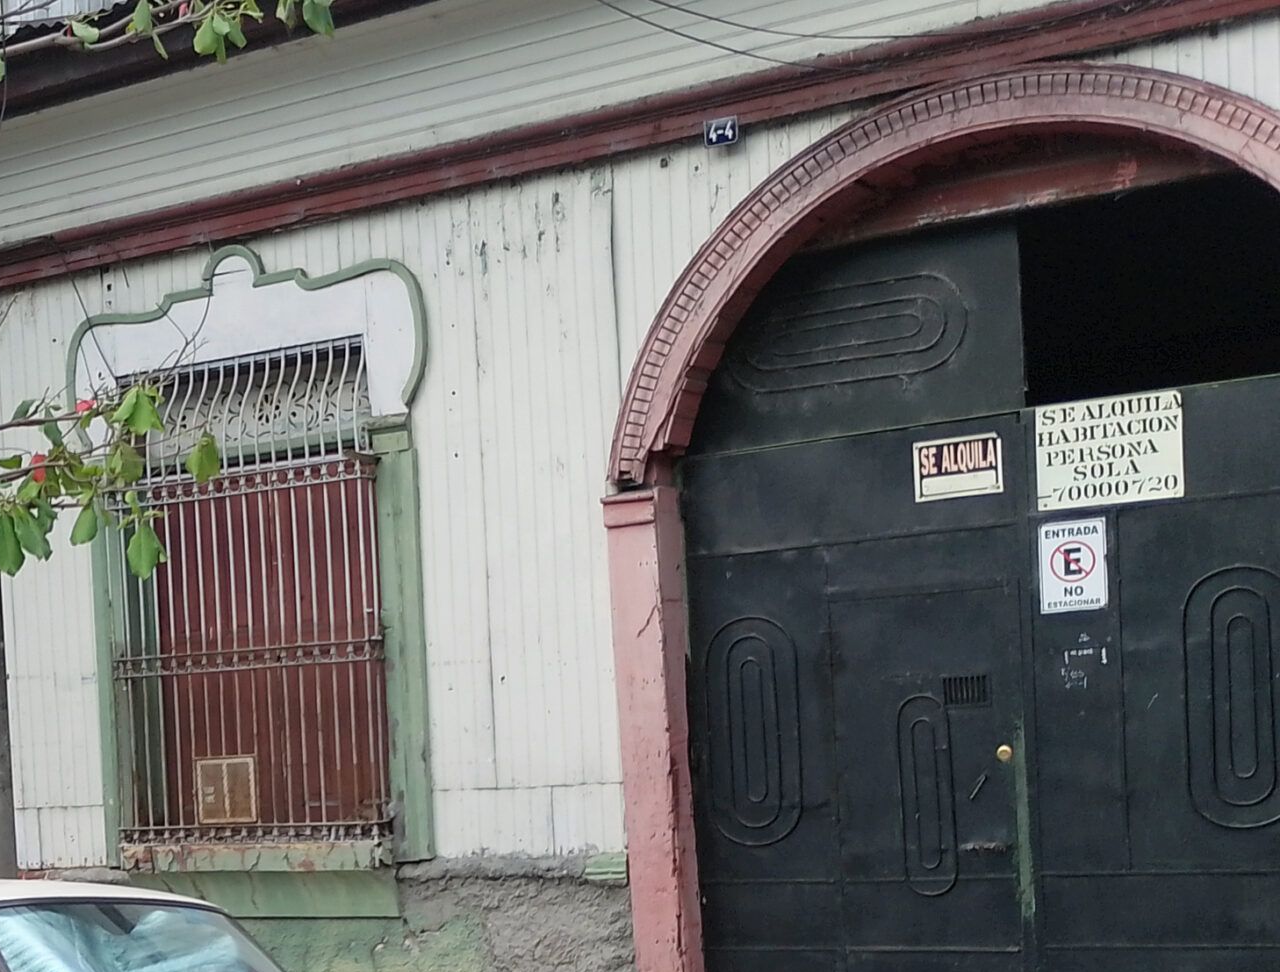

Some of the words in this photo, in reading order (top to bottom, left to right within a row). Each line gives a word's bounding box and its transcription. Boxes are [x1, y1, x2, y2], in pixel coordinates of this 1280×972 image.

[709, 120, 733, 142] 4-4
[1042, 407, 1075, 426] SE
[1080, 393, 1183, 420] ALQUILA
[1037, 414, 1179, 448] HABITACION
[920, 446, 938, 476] SE
[941, 438, 996, 473] ALQUILA
[1045, 438, 1159, 467] PERSONA
[1073, 459, 1141, 482] SOLA
[1044, 525, 1099, 540] ENTRADA
[1063, 547, 1082, 576] E
[1047, 597, 1101, 609] ESTACIONAR
[1063, 586, 1084, 598] NO
